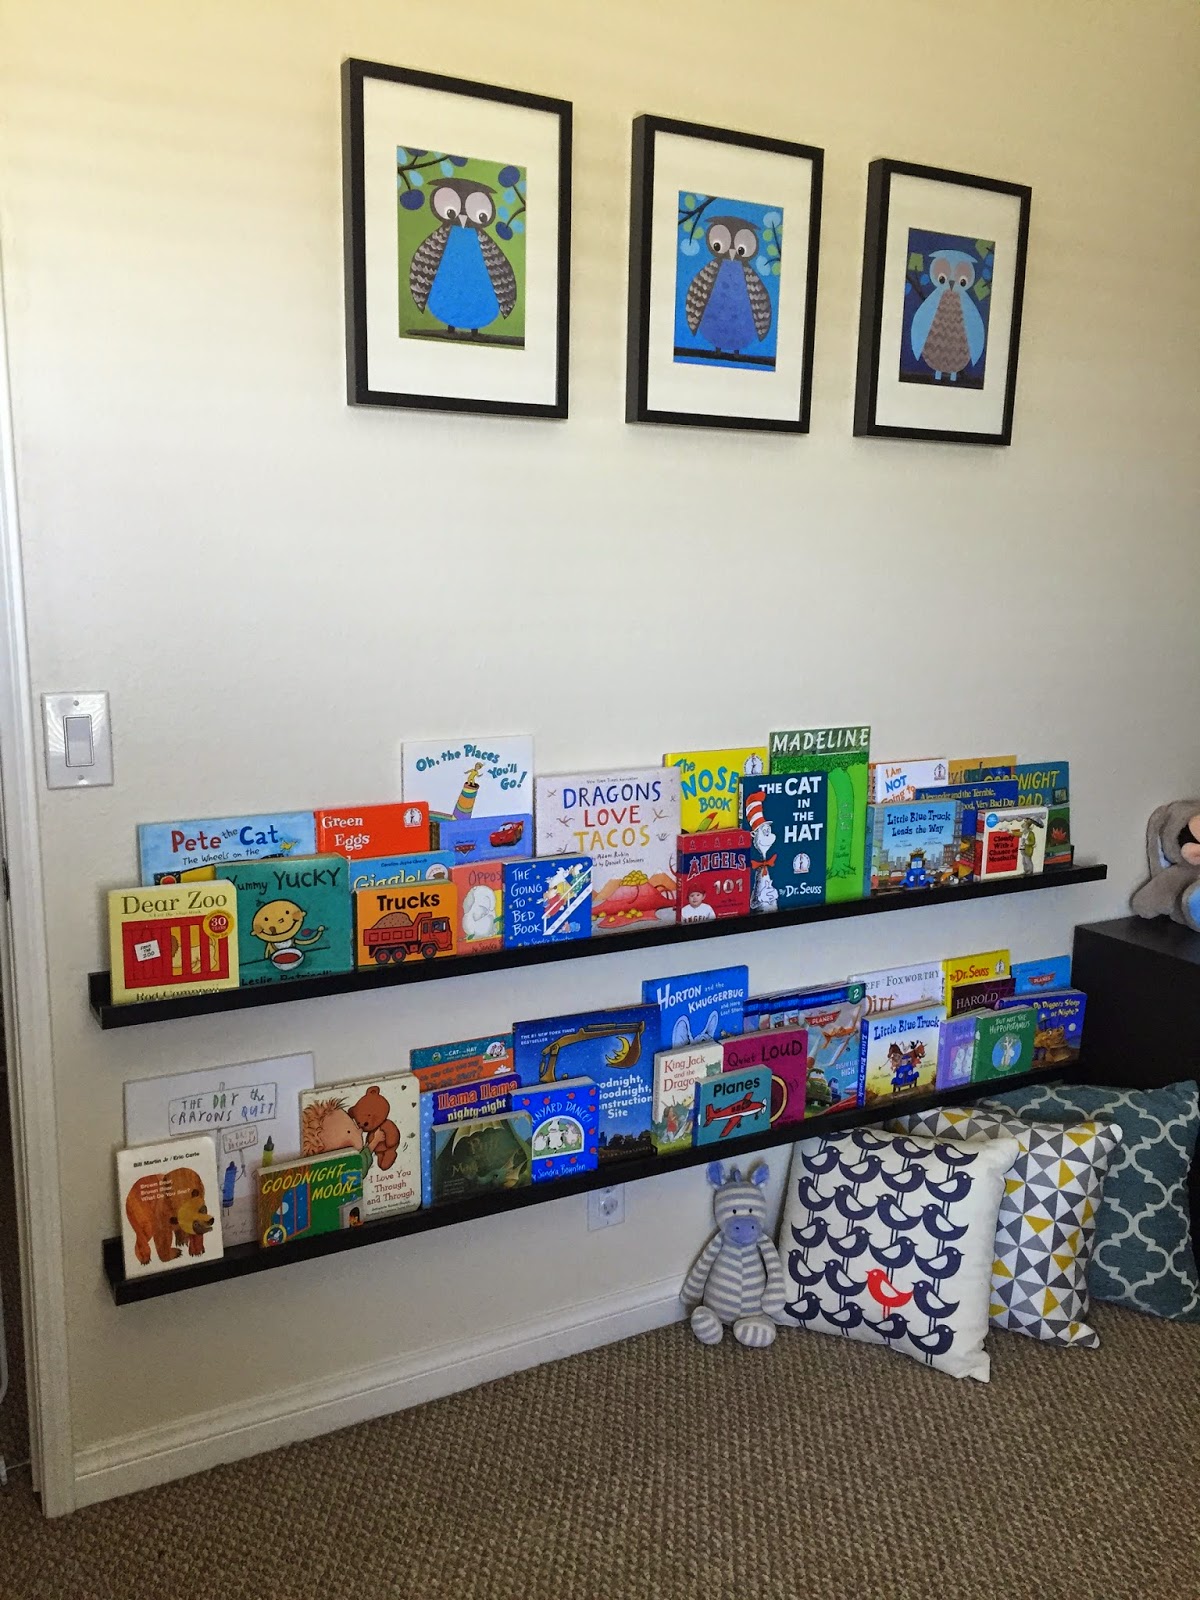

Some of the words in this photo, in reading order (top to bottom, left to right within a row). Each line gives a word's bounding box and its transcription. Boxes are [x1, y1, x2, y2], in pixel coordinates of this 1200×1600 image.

[772, 728, 869, 752] MADELINE
[416, 756, 440, 772] Oh,
[441, 750, 461, 761] the
[464, 744, 500, 763] Places
[674, 758, 695, 773] The
[487, 763, 517, 779] You'll
[891, 767, 902, 777] Am
[500, 771, 528, 790] Go!
[680, 766, 740, 800] NOSE
[759, 783, 782, 795] THE
[784, 776, 822, 796] CAT
[885, 775, 907, 793] NOT
[907, 785, 916, 794] to
[563, 781, 662, 809] DRAGONS
[797, 798, 810, 808] IN
[990, 799, 1002, 807] Bad
[698, 796, 732, 813] BOOK
[321, 815, 364, 829] Green
[584, 805, 641, 828] LOVE
[793, 811, 814, 821] THE
[887, 813, 909, 825] Little
[909, 812, 927, 823] Blue
[928, 809, 951, 821] Truck
[171, 830, 222, 852] Pete
[222, 828, 238, 839] the
[239, 824, 279, 846] Cat
[573, 825, 650, 851] TACOS
[784, 823, 824, 843] HAT
[891, 826, 913, 837] Leads
[915, 825, 927, 834] the
[928, 824, 944, 834] Way
[334, 832, 371, 852] Eggs
[182, 856, 199, 866] The
[201, 851, 230, 863] Wheels
[245, 847, 260, 856] the
[512, 867, 532, 881] THE
[687, 851, 747, 881] ANGELS
[225, 874, 268, 896] Yummy
[273, 867, 342, 890] YUCKY
[469, 869, 502, 886] OPPOS
[713, 878, 743, 895] 101
[510, 884, 543, 898] GOING
[785, 884, 800, 897] Dr.
[800, 882, 822, 895] Seuss
[121, 896, 180, 915] Dear
[188, 891, 228, 910] Zoo
[377, 892, 441, 911] Trucks
[512, 898, 526, 908] TO
[211, 917, 227, 927] 30
[511, 910, 536, 923] BED
[511, 922, 542, 936] BOOK
[241, 976, 273, 986] Leslie
[865, 981, 881, 990] EFF
[886, 970, 940, 987] FOXWORTHY
[955, 970, 968, 983] Dr.
[969, 965, 989, 977] Seuss
[656, 983, 702, 1011] HORTON
[688, 988, 744, 1014] KWUGGERBUG
[853, 988, 859, 999] 2
[957, 992, 999, 1009] HAROLD
[812, 1015, 834, 1024] PLANES
[873, 1023, 897, 1040] Little
[898, 1018, 917, 1034] Blue
[917, 1015, 940, 1029] Truck
[728, 1051, 755, 1066] Quiet
[761, 1040, 803, 1062] LOUD
[664, 1058, 685, 1074] King
[686, 1055, 706, 1069] Jack
[597, 1074, 643, 1088] odnight,
[674, 1070, 685, 1079] and
[438, 1090, 478, 1110] llama
[480, 1080, 518, 1100] llama
[713, 1077, 760, 1098] Planes
[182, 1098, 203, 1110] THE
[213, 1092, 239, 1109] DAY
[250, 1088, 265, 1102] the
[599, 1094, 653, 1110] nstruction
[170, 1109, 232, 1125] CRAYONS
[241, 1102, 274, 1121] QUIT
[447, 1098, 506, 1121] nighty-night
[565, 1101, 593, 1122] DANCE!
[607, 1108, 628, 1119] Site
[261, 1163, 346, 1195] GOODNIGHT
[369, 1175, 373, 1183] I
[376, 1174, 394, 1182] Love
[396, 1169, 412, 1178] You
[537, 1167, 559, 1179] Sandra
[560, 1163, 586, 1174] Boynton
[311, 1179, 355, 1201] MOON
[374, 1179, 407, 1193] Through
[366, 1195, 381, 1206] and
[383, 1188, 415, 1202] Through
